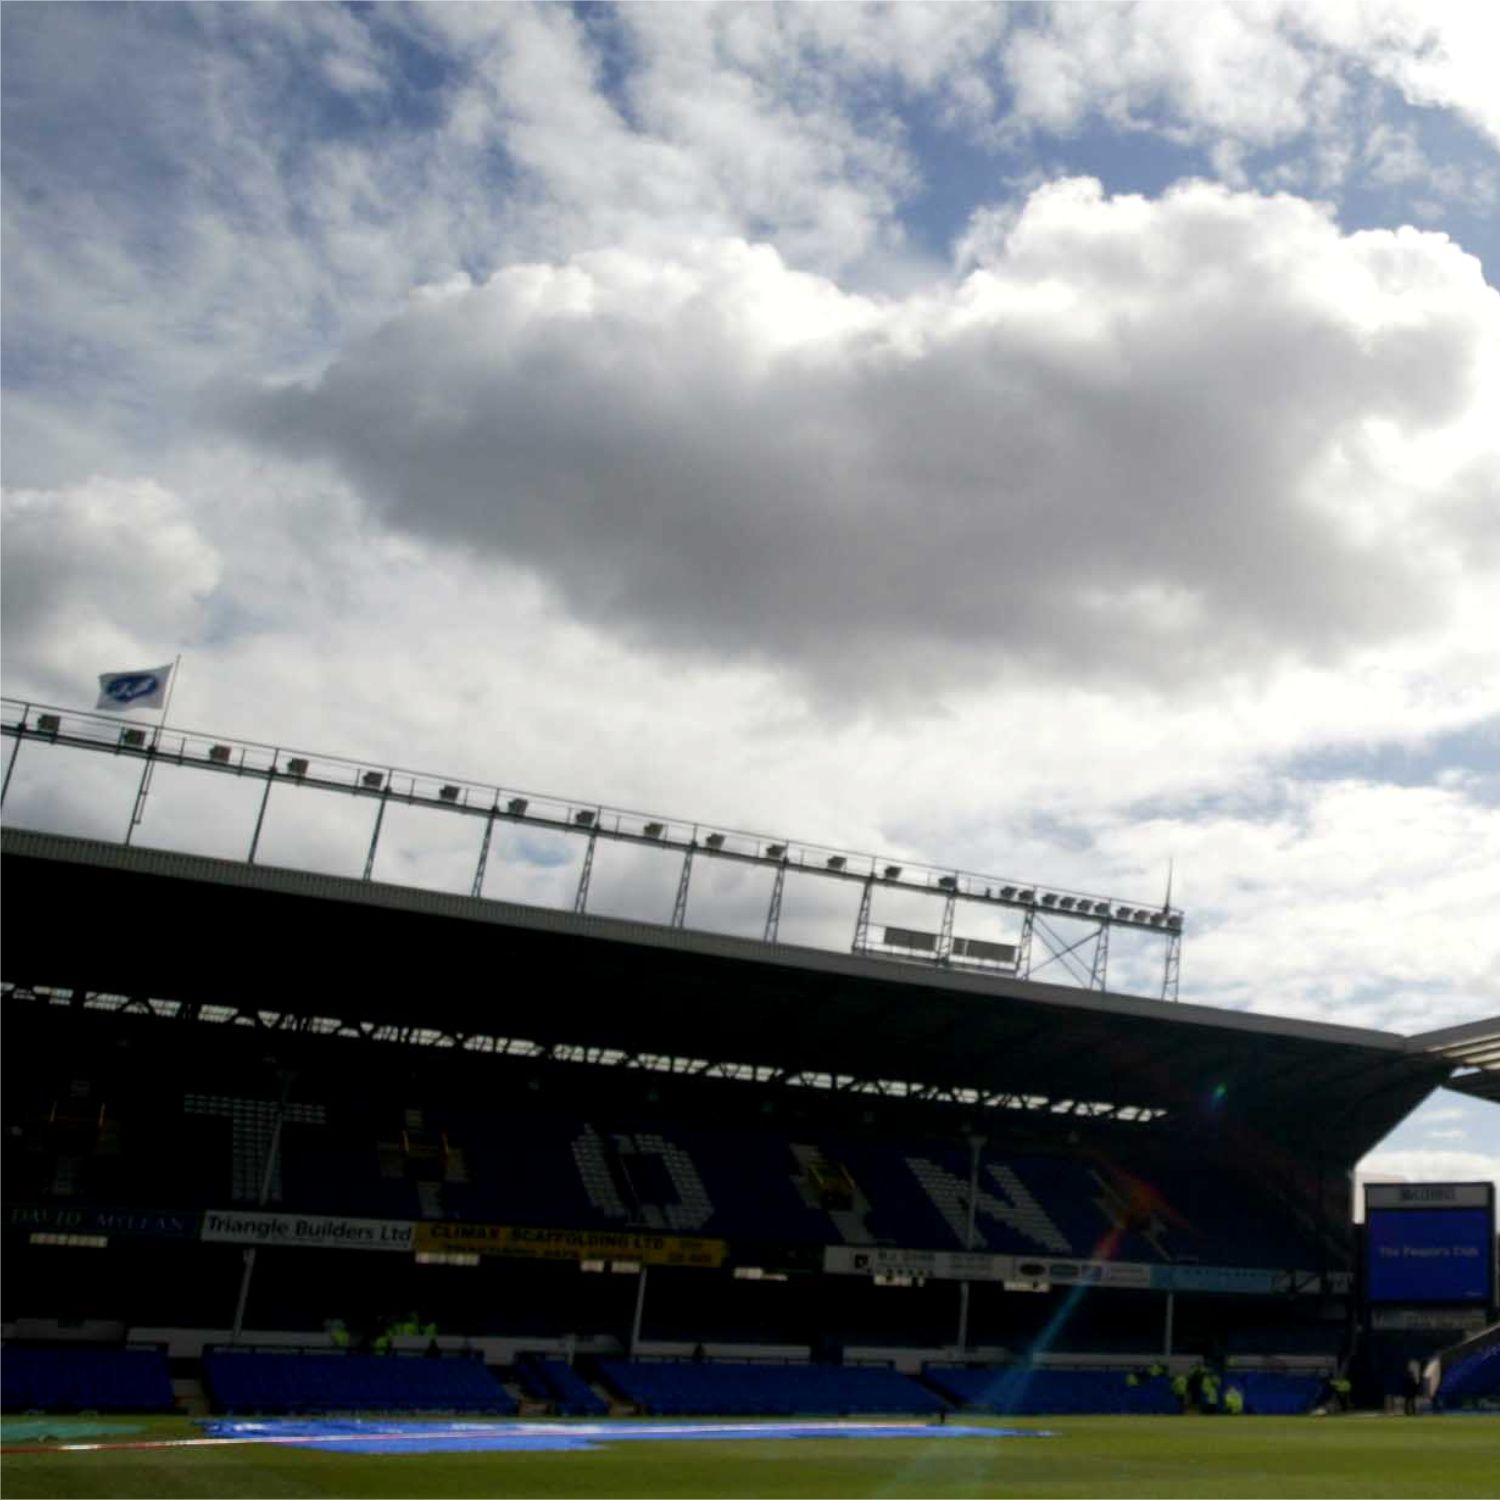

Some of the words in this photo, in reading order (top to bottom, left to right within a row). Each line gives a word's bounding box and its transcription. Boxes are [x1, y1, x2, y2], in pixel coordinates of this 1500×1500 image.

[207, 1215, 289, 1239] Triangle
[295, 1219, 374, 1240] Builders
[381, 1227, 412, 1242] Ltd
